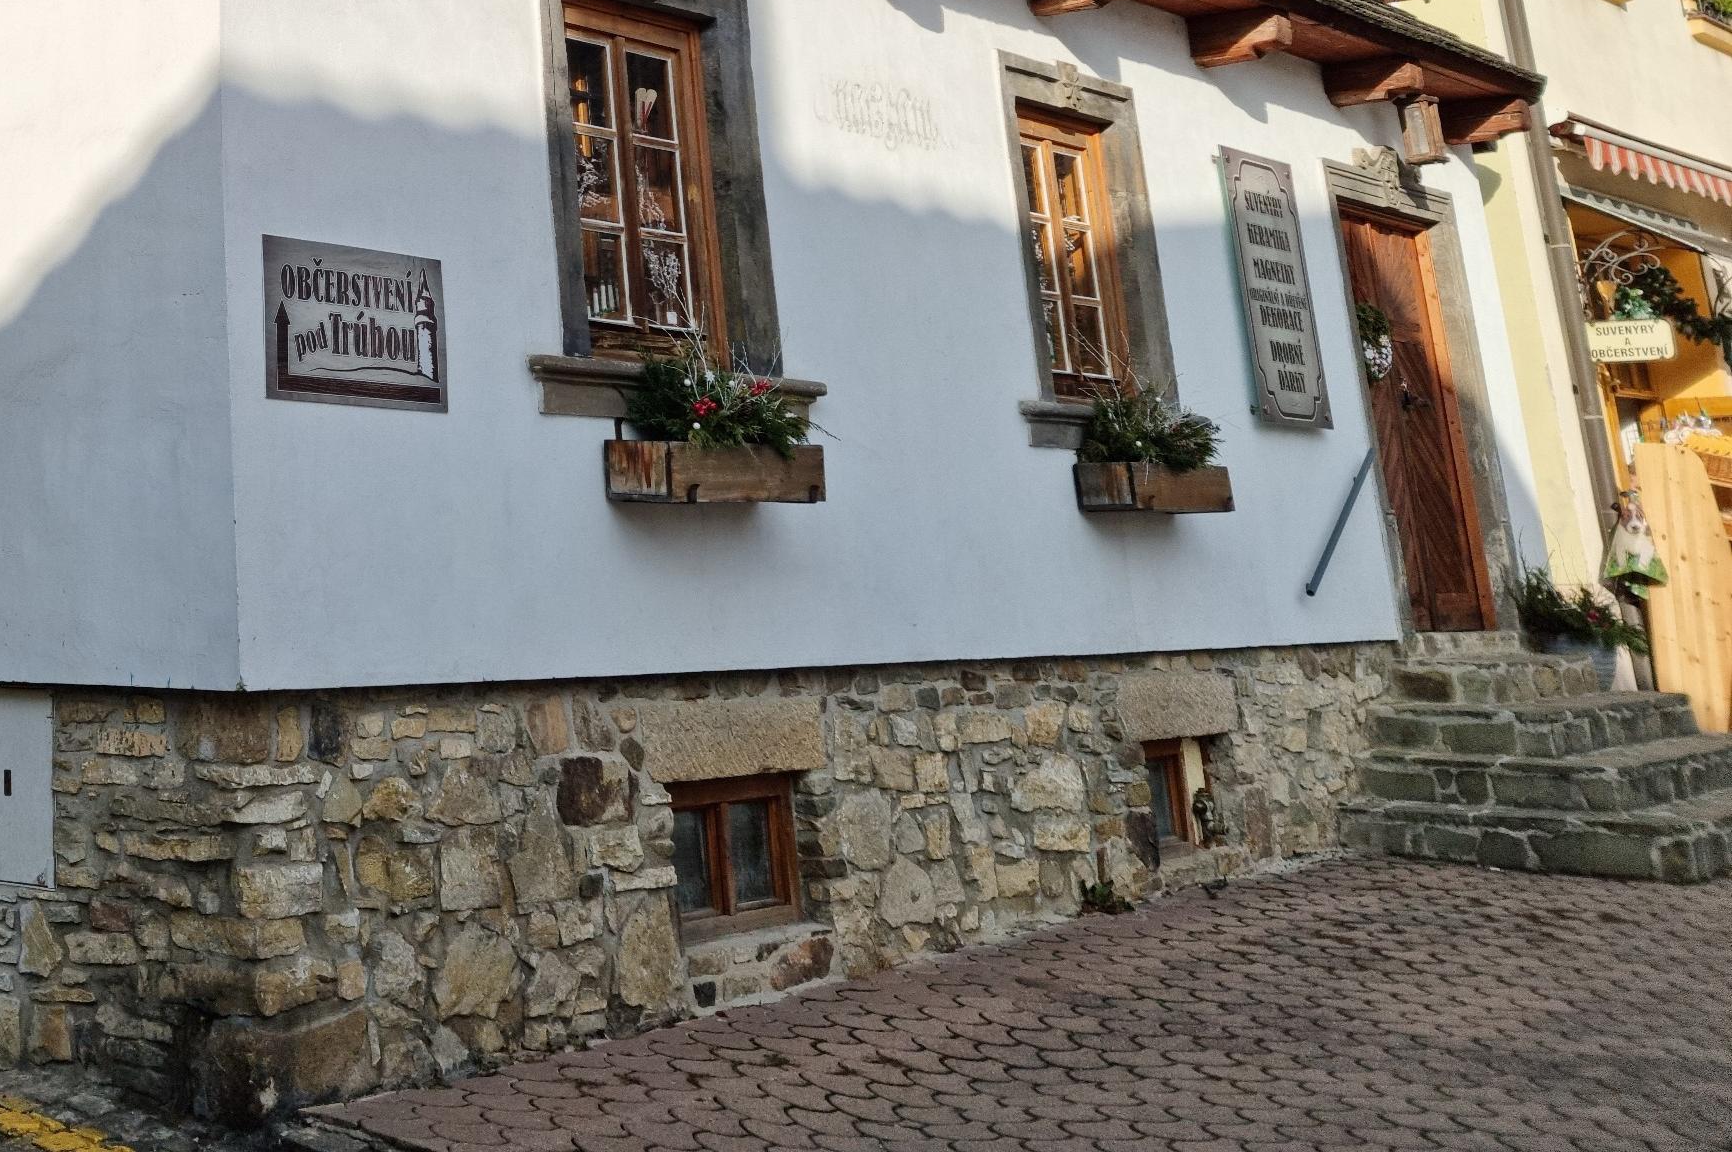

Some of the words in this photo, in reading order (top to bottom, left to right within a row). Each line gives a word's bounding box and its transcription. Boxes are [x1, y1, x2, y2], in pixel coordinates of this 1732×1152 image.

[1247, 223, 1291, 252] KERAMIKA
[1252, 257, 1296, 285] MAGNETKY
[280, 257, 414, 314] OBČERSTVENÍ
[1259, 304, 1304, 332] DEKORACE
[1595, 322, 1655, 337] SUVENÝRY
[294, 321, 329, 363] pod
[329, 310, 416, 363] Trúbou
[1624, 336, 1631, 346] A
[1269, 338, 1305, 365] DROBNÉ
[1591, 344, 1669, 359] OBČERSTVENÍ
[1277, 364, 1307, 394] DÁRKY
